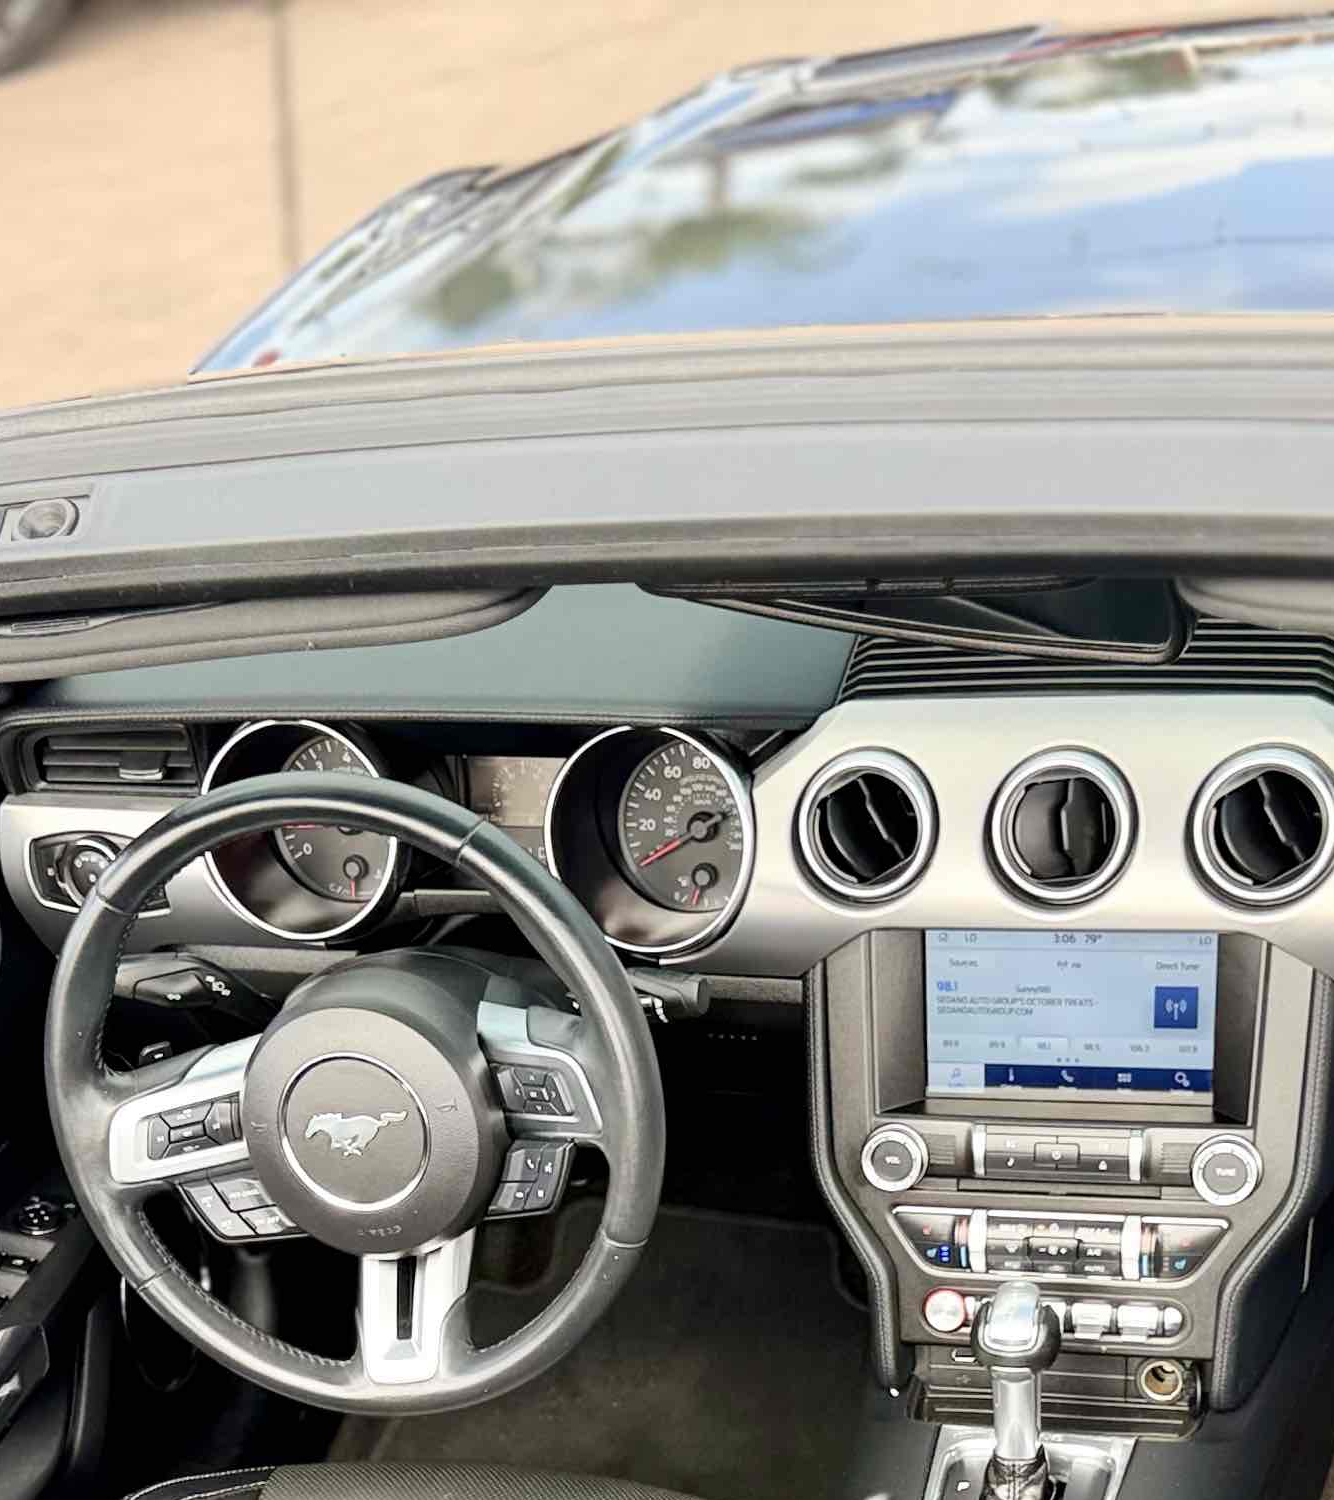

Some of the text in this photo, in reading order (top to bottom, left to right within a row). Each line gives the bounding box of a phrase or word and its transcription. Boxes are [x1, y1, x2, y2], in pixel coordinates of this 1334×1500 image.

[692, 756, 711, 769] 80
[663, 765, 682, 779] 60
[643, 788, 662, 801] 40
[638, 818, 656, 831] 20
[302, 842, 313, 855] 0
[957, 1481, 971, 1492] P
